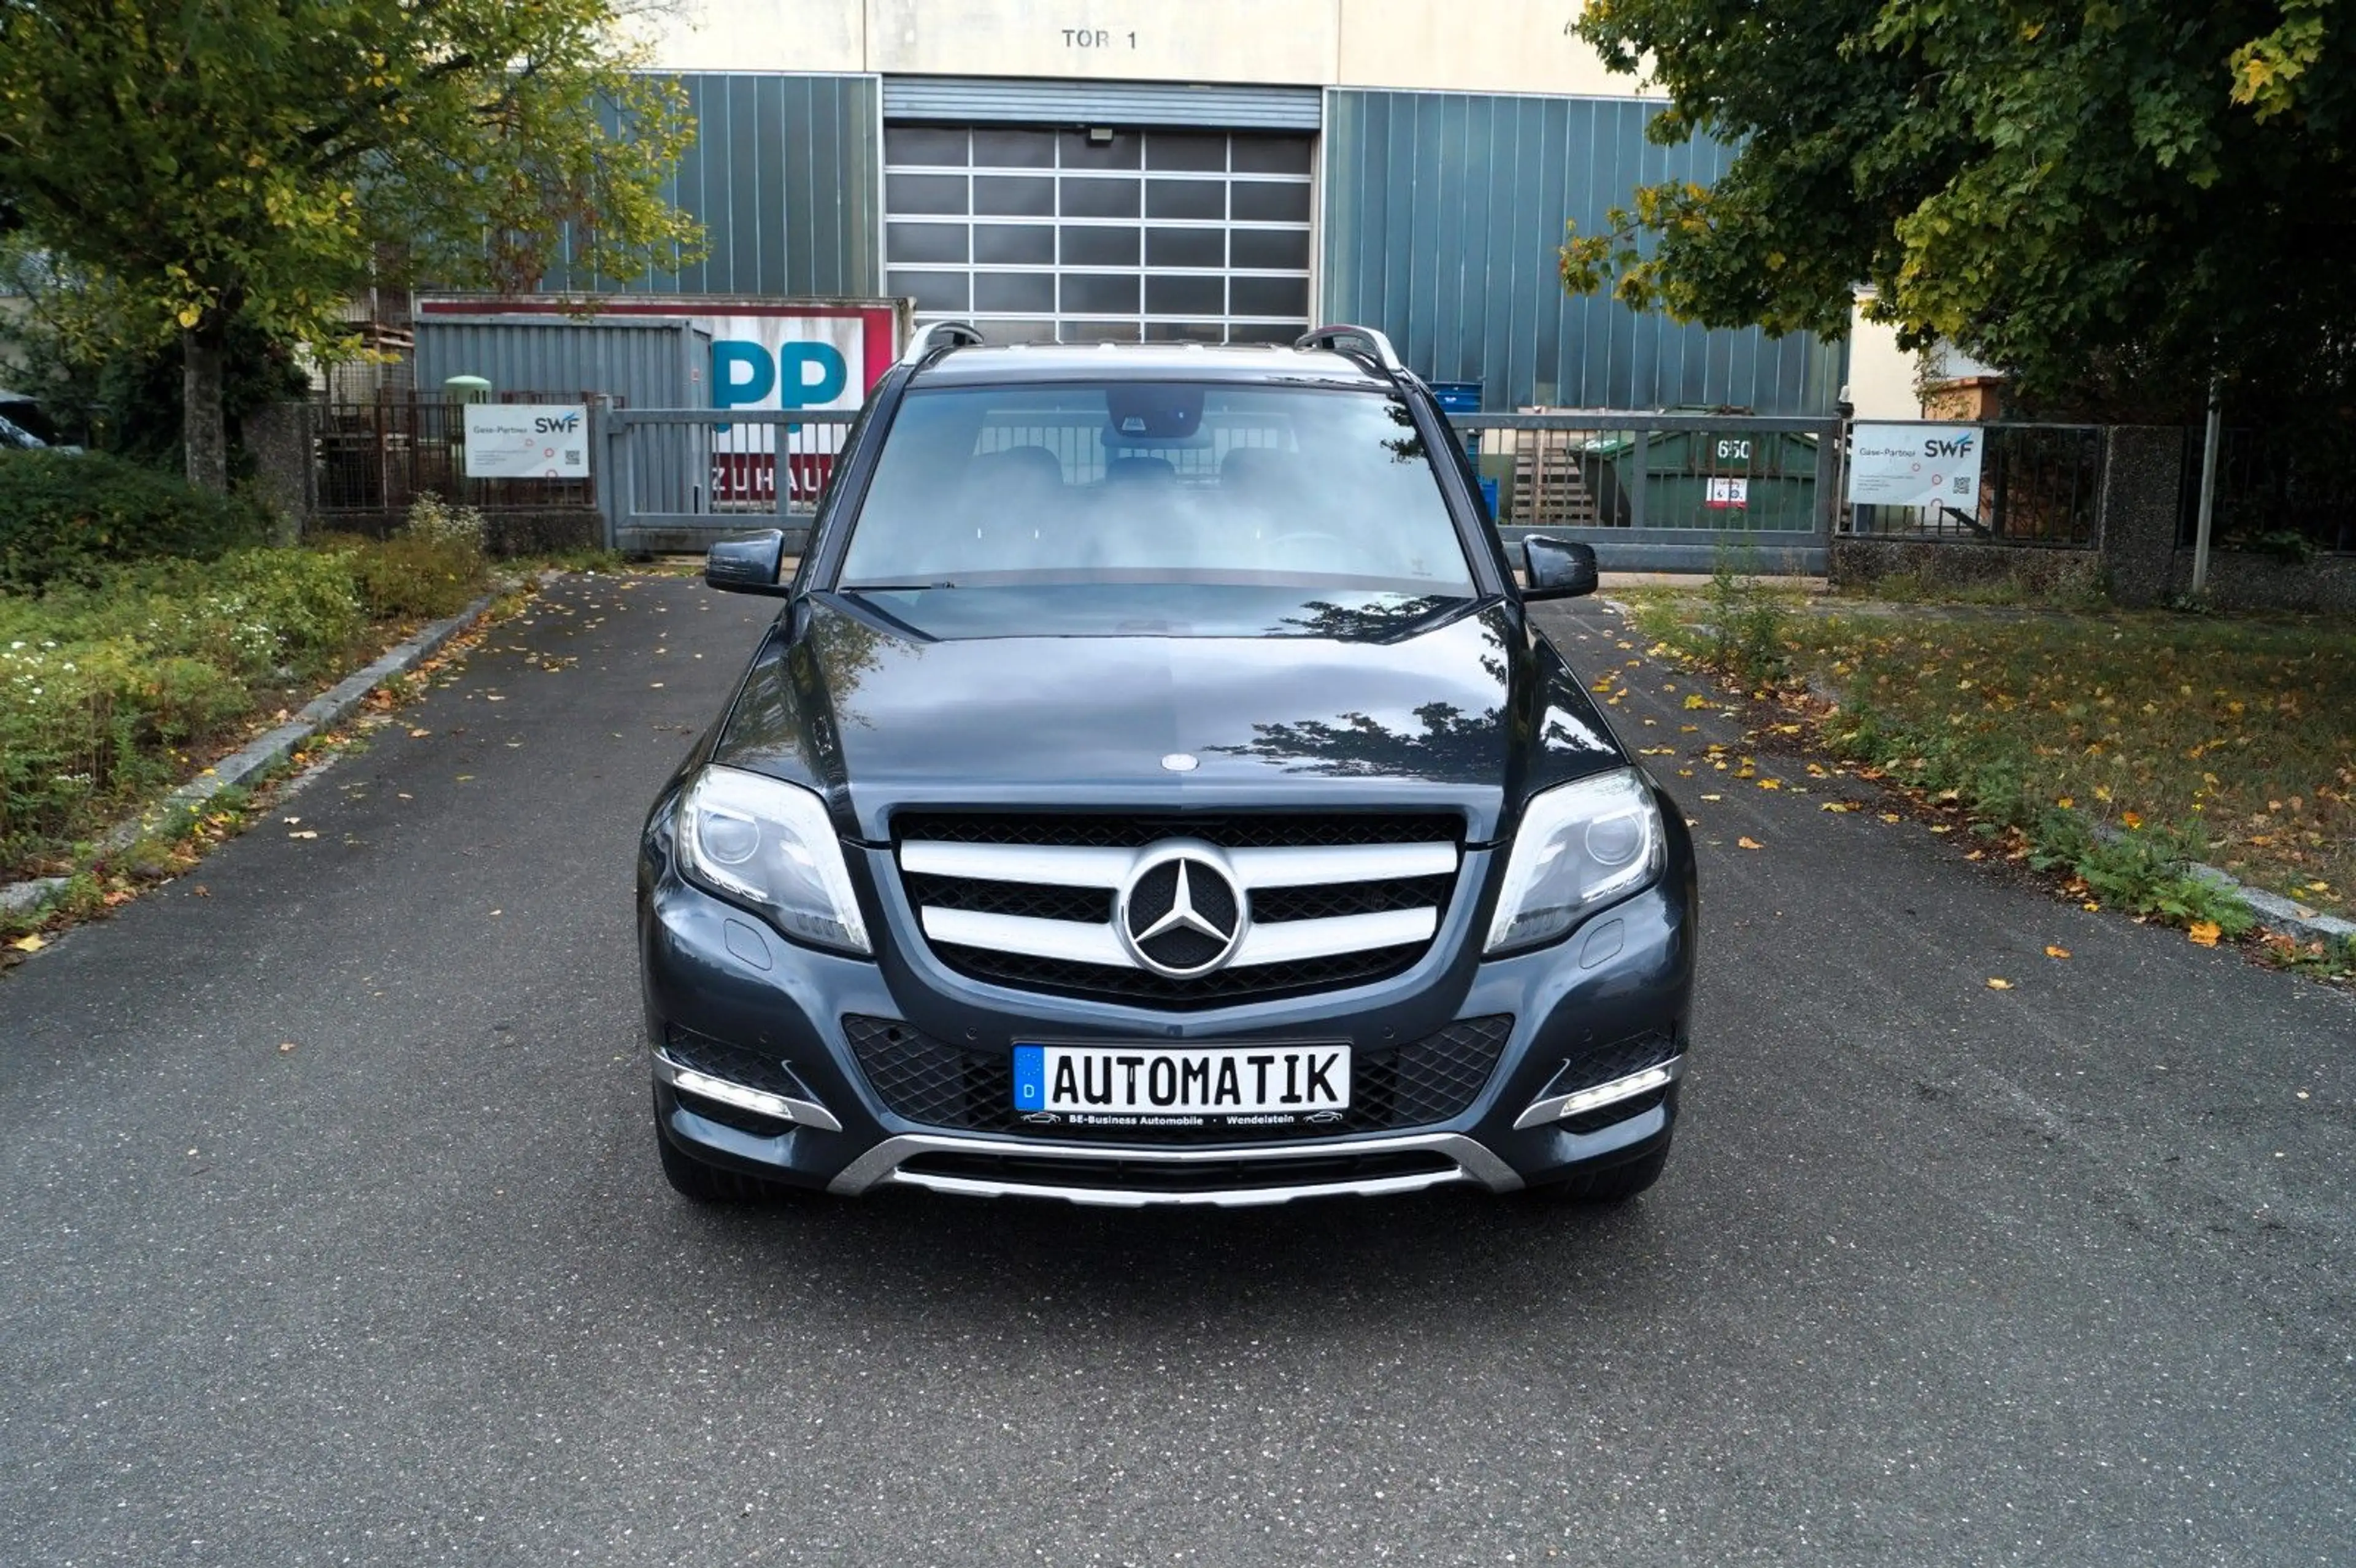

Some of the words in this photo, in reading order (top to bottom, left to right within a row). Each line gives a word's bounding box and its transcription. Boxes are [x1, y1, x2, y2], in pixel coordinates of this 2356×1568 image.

[1061, 29, 1109, 48] TOR
[1127, 31, 1136, 49] 1
[535, 417, 579, 434] SWF
[1924, 439, 1974, 458] SWF
[1023, 1084, 1035, 1098] D
[1052, 1053, 1339, 1106] AUTOMATIK
[1069, 1115, 1137, 1125] BE-Business
[1140, 1116, 1204, 1126] Automobile
[1226, 1114, 1295, 1125] Wendelstein
